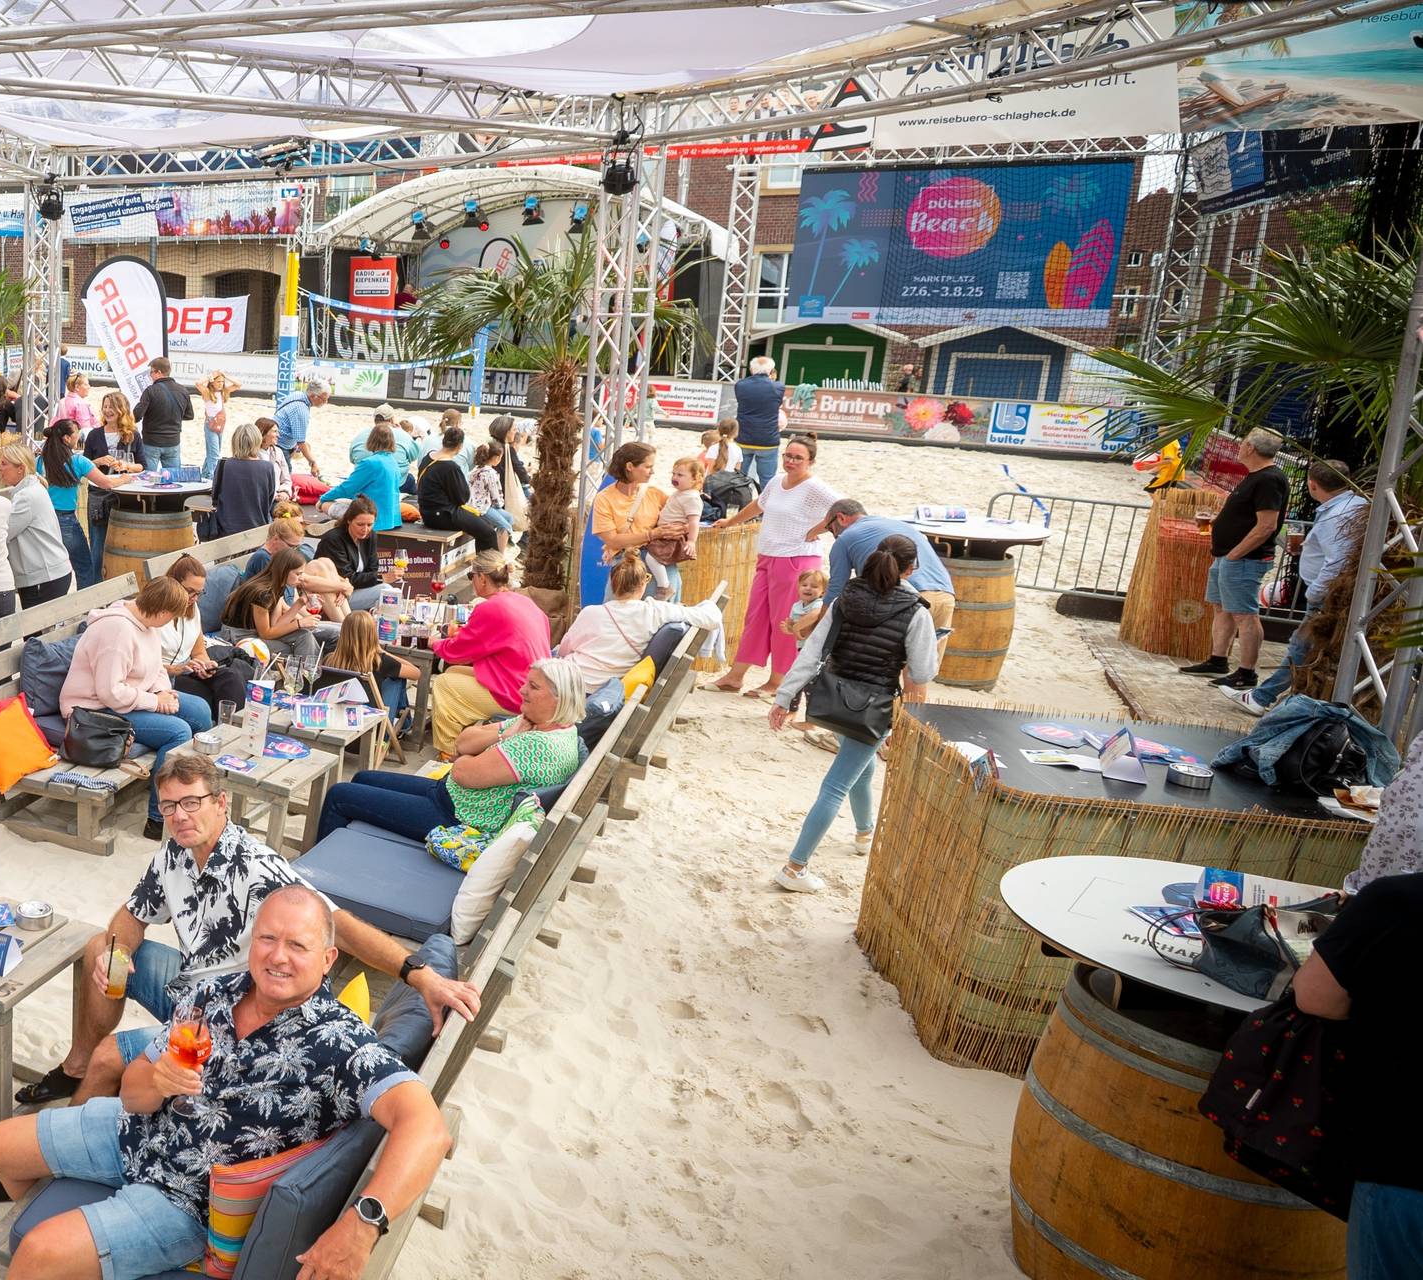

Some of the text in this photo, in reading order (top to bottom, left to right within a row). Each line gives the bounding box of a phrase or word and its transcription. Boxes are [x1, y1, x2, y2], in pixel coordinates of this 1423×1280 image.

[898, 106, 1077, 128] www.reisebuero-schlagheck.de
[70, 201, 113, 215] Engagement
[125, 195, 142, 207] gute
[927, 197, 982, 210] DÜLMEN
[73, 199, 174, 224] Stimmung und unsere Region.
[909, 209, 994, 234] Beach
[913, 274, 977, 284] MARKTPLATZ
[93, 276, 150, 371] BOER
[70, 361, 104, 373] RNING
[173, 360, 205, 375] TTEN
[439, 368, 530, 396] LANE BAU
[673, 385, 718, 395] Beitragseinzug
[499, 395, 528, 408] LANGE
[820, 394, 892, 418] Brintrup
[789, 410, 820, 420] Floristik
[1046, 410, 1090, 420] Heizungen
[1054, 418, 1079, 426] Bäder
[1040, 424, 1091, 434] Solarwärme
[1042, 431, 1088, 440] Solarstrom
[988, 434, 1027, 446] bulter
